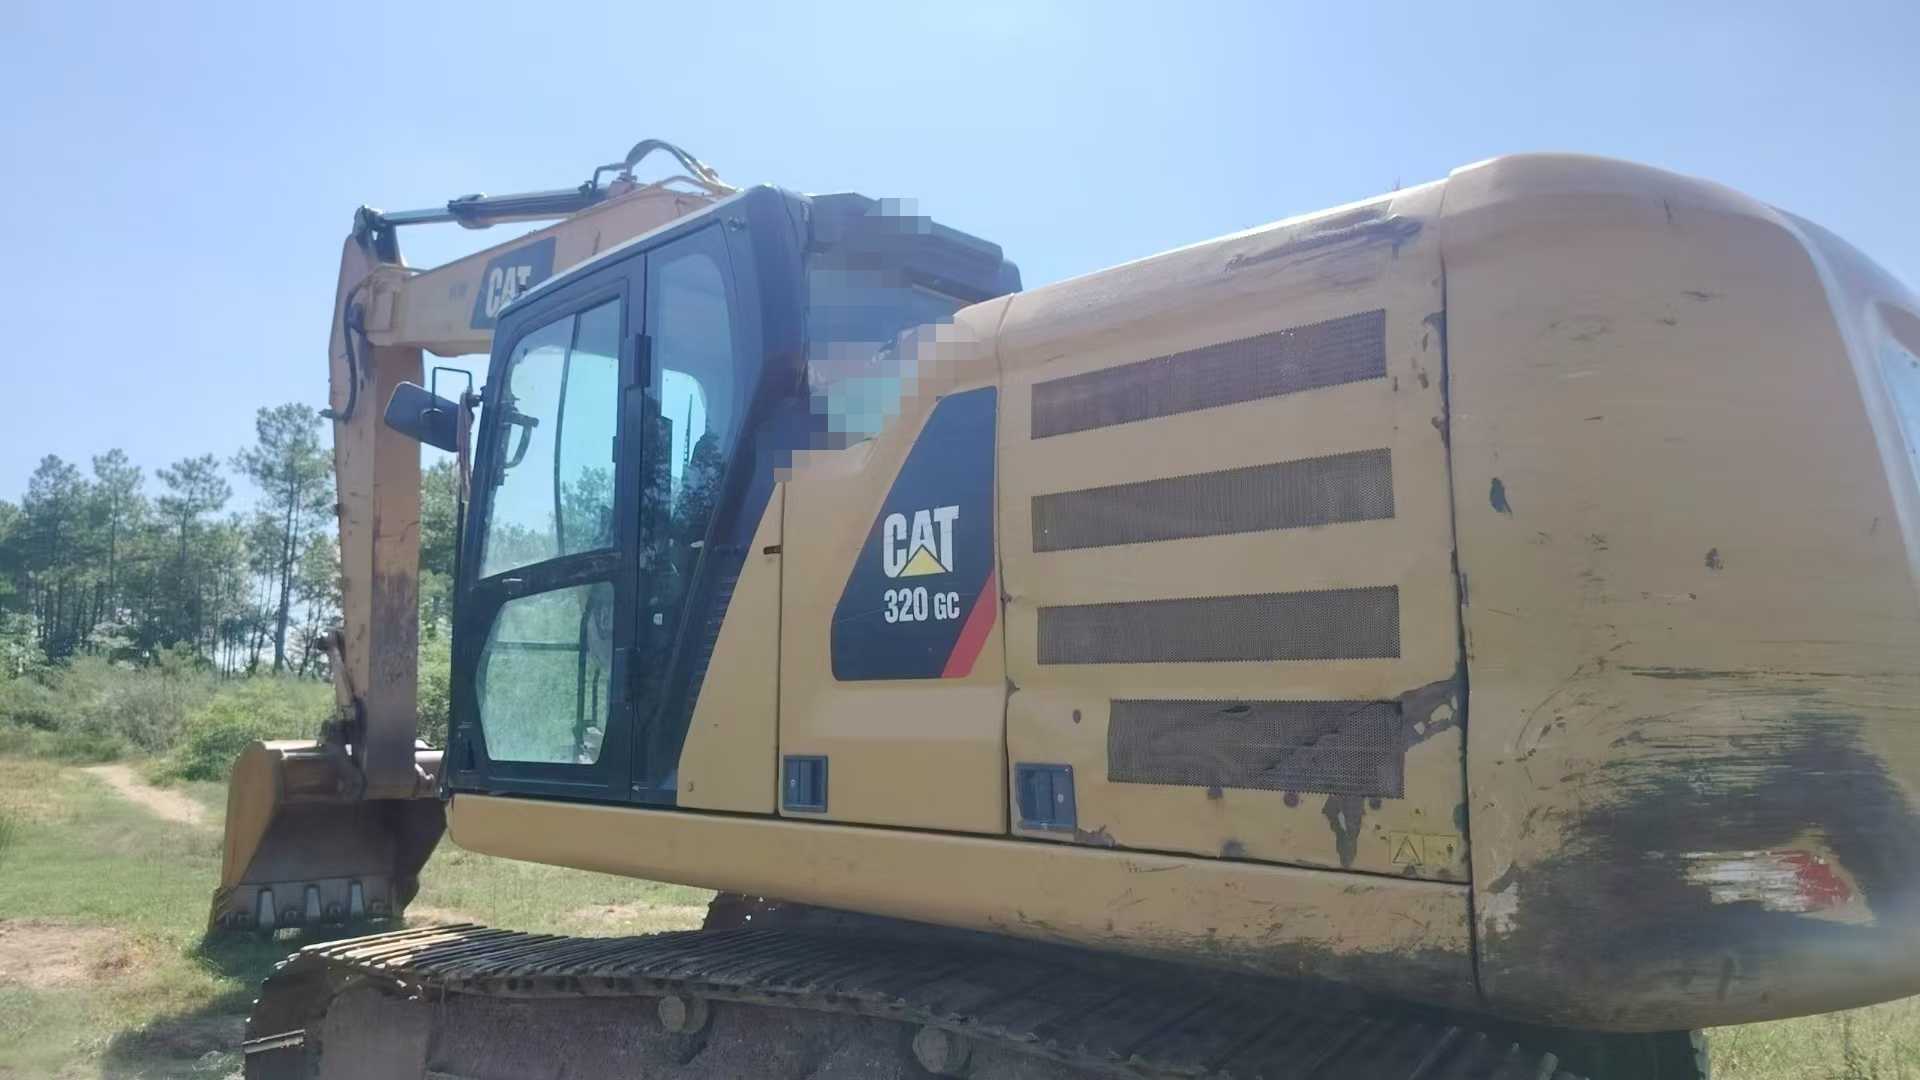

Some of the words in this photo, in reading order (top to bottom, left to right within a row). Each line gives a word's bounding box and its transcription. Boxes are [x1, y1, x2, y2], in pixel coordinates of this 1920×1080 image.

[883, 505, 960, 578] CAT
[884, 586, 929, 623] 320
[933, 591, 960, 620] GC
